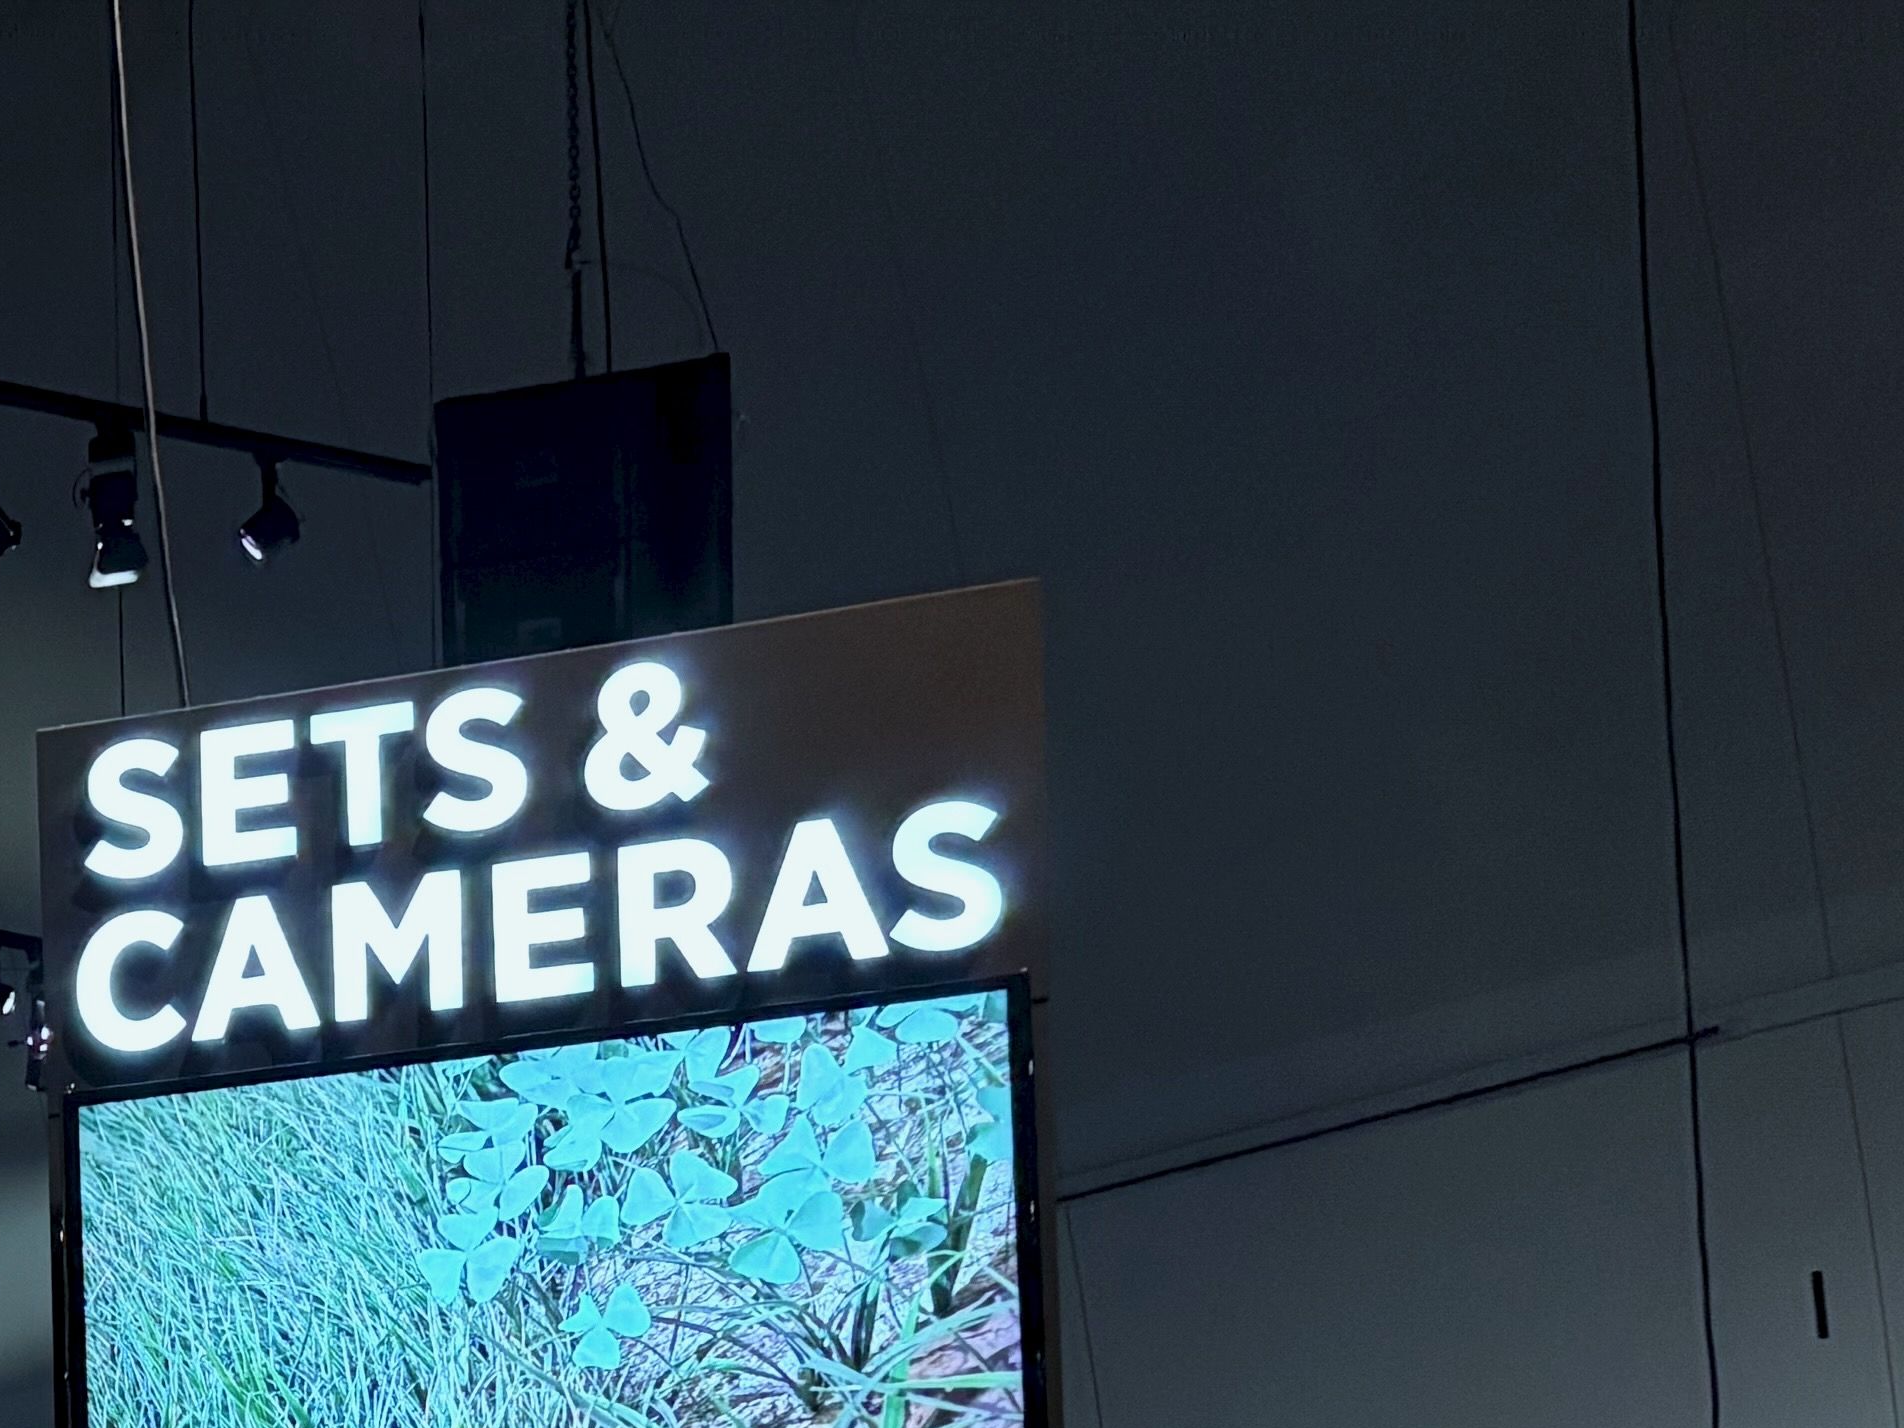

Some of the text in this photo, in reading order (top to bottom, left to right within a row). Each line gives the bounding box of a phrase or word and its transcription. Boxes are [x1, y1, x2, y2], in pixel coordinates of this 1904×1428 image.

[83, 660, 711, 881] SETS &
[74, 799, 1004, 1054] CAMERAS
